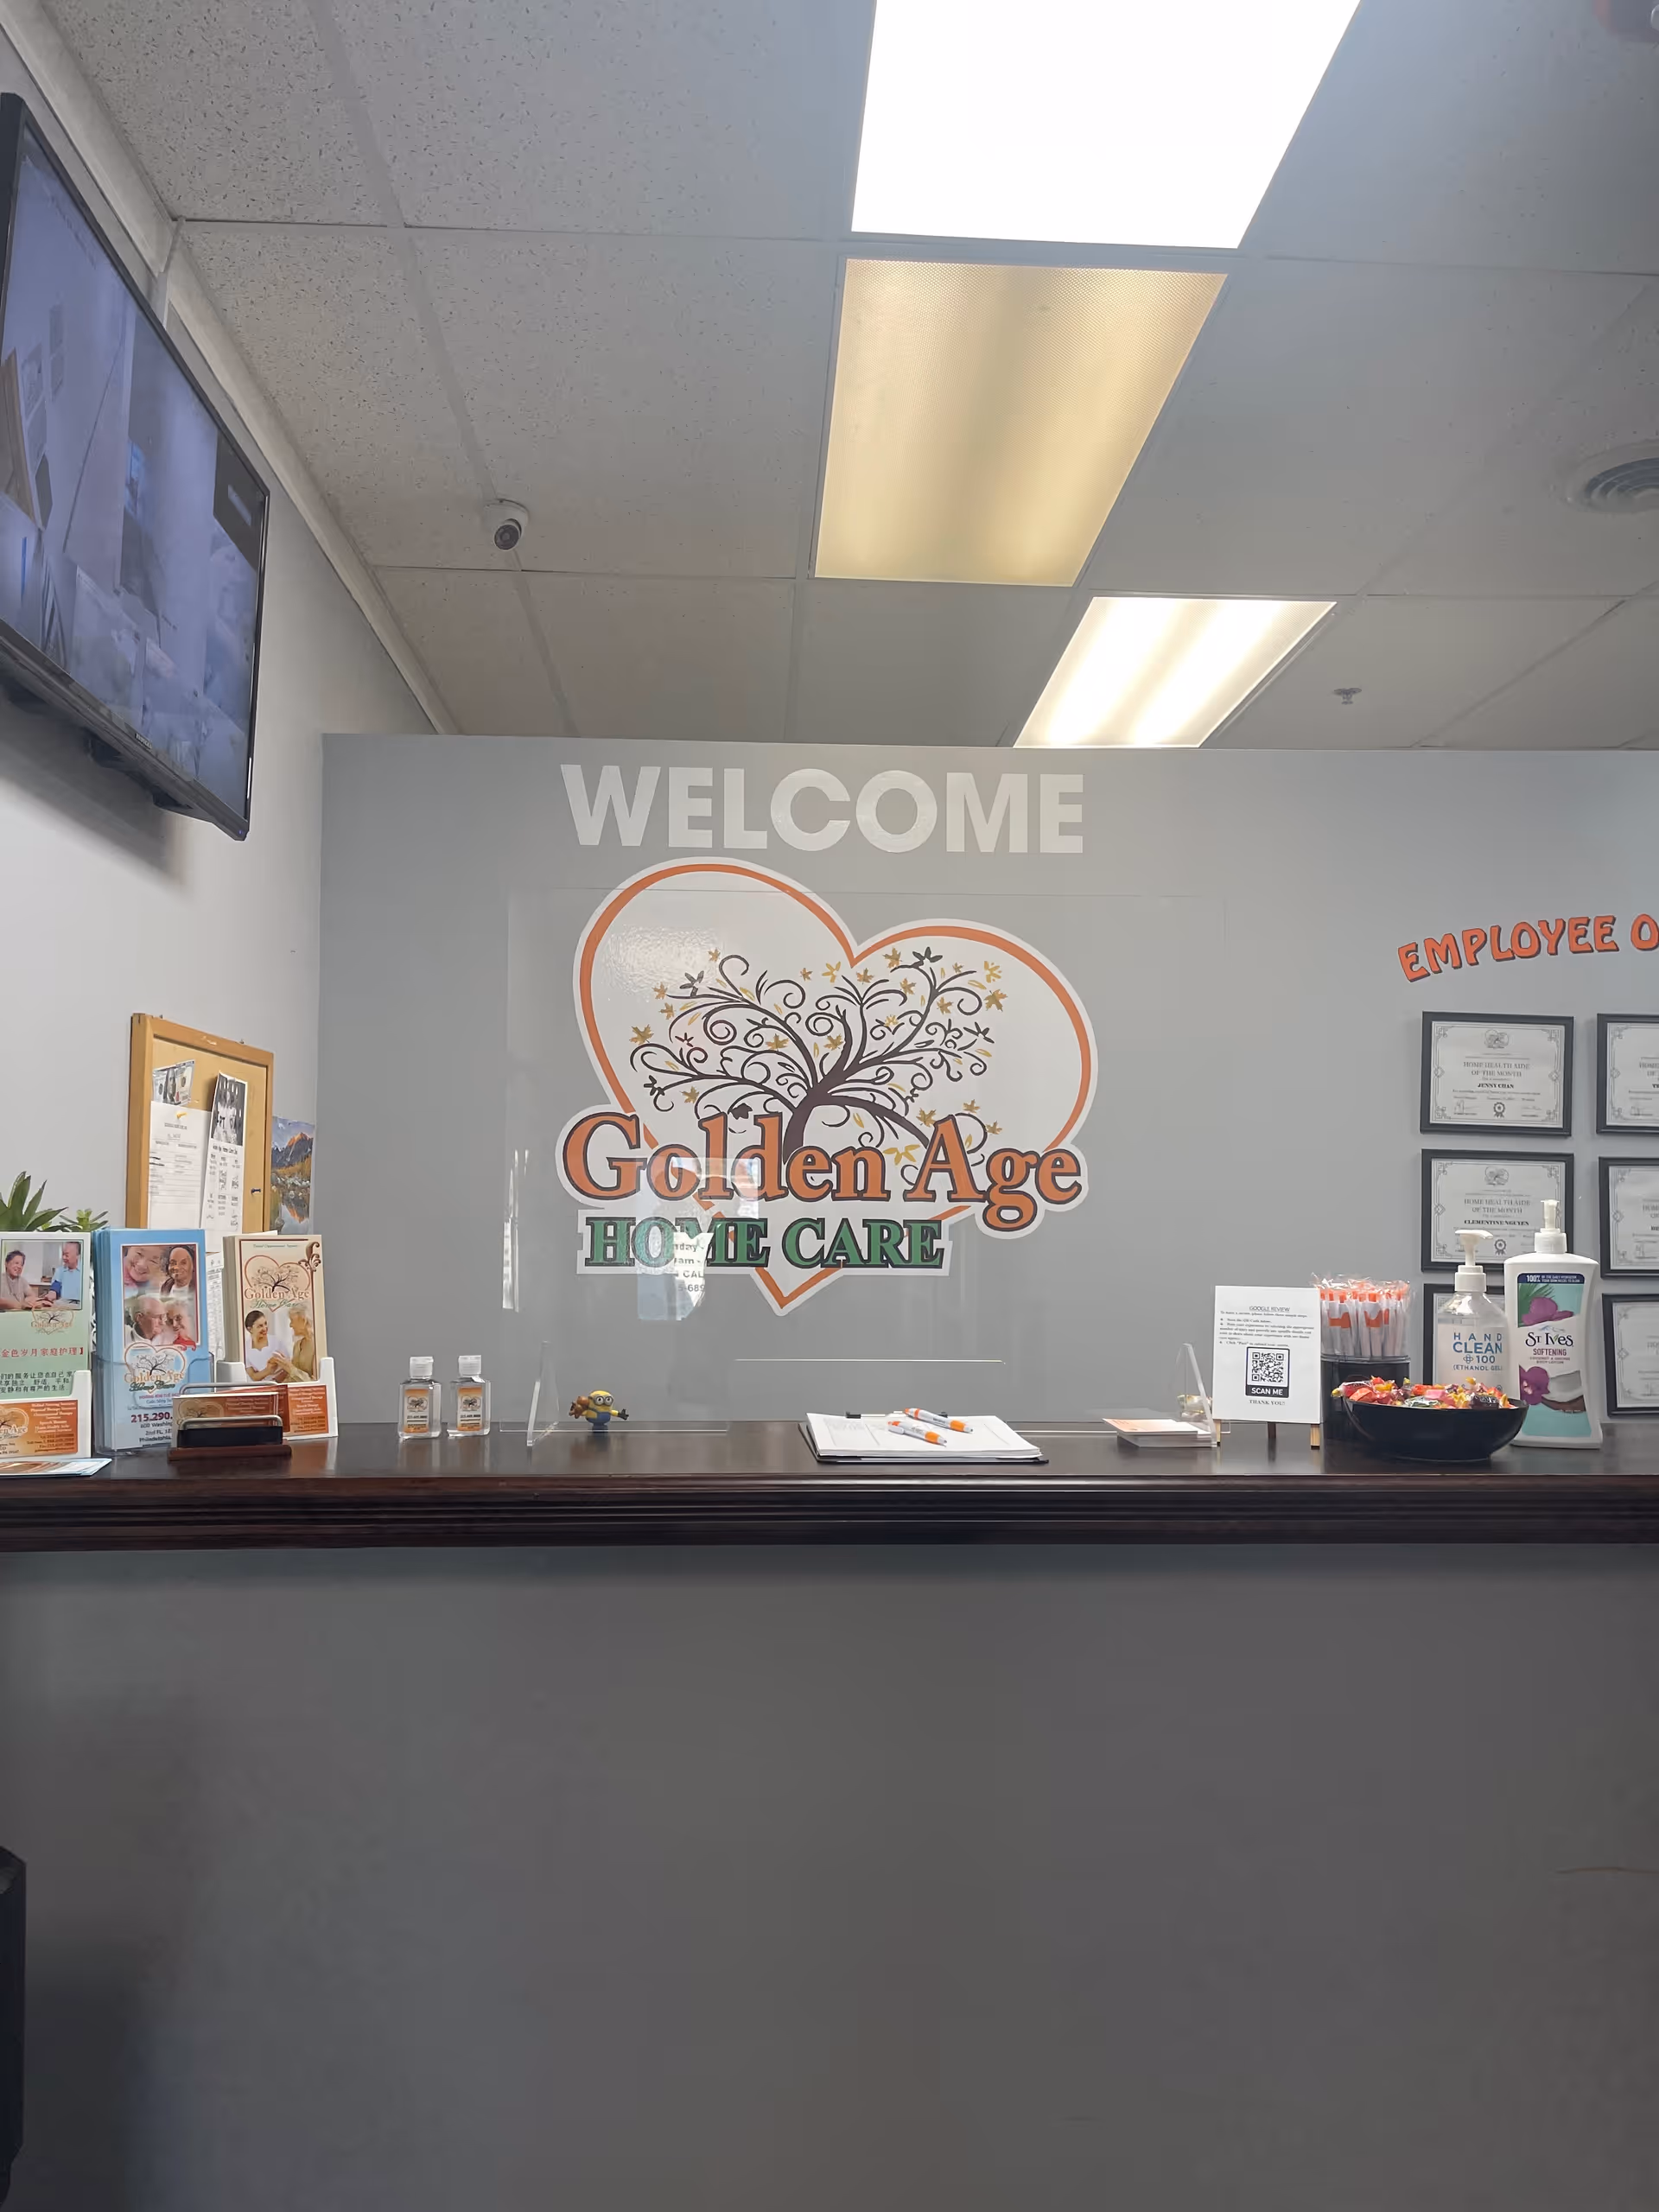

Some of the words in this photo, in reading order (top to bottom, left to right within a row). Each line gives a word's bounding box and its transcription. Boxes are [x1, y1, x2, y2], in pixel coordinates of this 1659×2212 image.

[560, 764, 1084, 853] WELCOME
[1397, 914, 1619, 983] EMPLOYEE
[563, 1112, 891, 1202] Golden
[904, 1114, 1082, 1231] Age
[584, 1217, 771, 1268] HOME
[781, 1217, 944, 1270] CARE
[1526, 1274, 1541, 1283] 100%
[244, 1287, 285, 1300] Golden
[288, 1287, 309, 1300] Age
[1453, 1332, 1503, 1342] HAND
[1452, 1341, 1503, 1354] CLEAN
[1476, 1355, 1495, 1363] 100
[124, 1371, 162, 1383] Golden
[166, 1370, 185, 1382] Age
[129, 1382, 155, 1392] Home
[130, 1411, 173, 1423] 215.290.
